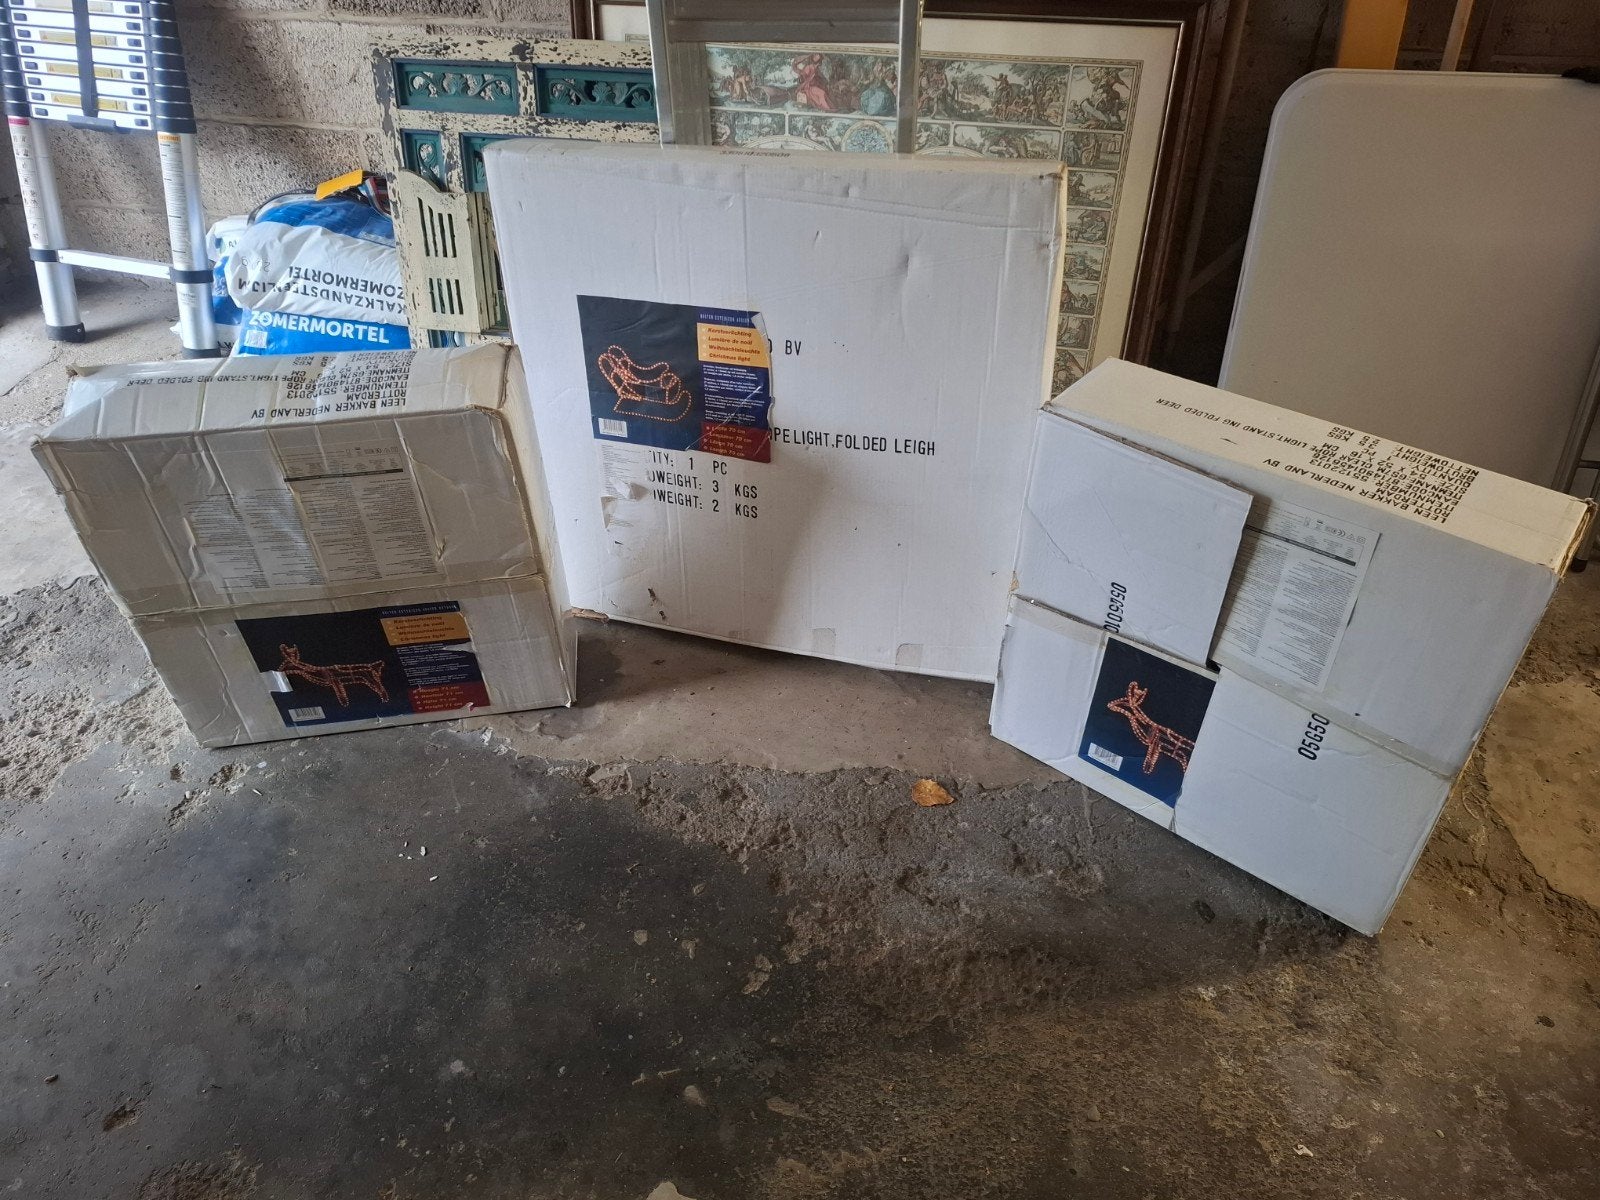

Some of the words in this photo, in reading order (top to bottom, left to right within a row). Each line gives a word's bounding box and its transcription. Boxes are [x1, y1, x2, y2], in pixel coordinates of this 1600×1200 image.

[250, 311, 390, 344] ZOMERMORTEL
[785, 340, 802, 356] BV
[158, 376, 193, 385] FOLDED
[347, 389, 406, 401] ROTTERDAM
[336, 401, 376, 411] BAKKER
[381, 398, 405, 407] LEEN
[1155, 398, 1182, 409] DEER
[251, 409, 265, 418] BV
[271, 404, 330, 417] NEDERLAND
[1184, 406, 1220, 422] FOLDED
[1222, 418, 1241, 428] ING
[1327, 431, 1350, 442] KGS
[1331, 426, 1354, 437] KGS
[895, 438, 935, 456] LEIGH
[1309, 445, 1337, 458] ROPE
[1322, 442, 1339, 452] CM
[1361, 448, 1376, 456] PC
[1349, 450, 1363, 459] 16
[650, 450, 674, 466] ITY:
[689, 457, 694, 470] 1
[713, 460, 728, 475] PC
[1263, 458, 1280, 467] BV
[1339, 454, 1373, 469] CLEAR
[1377, 459, 1394, 469] 52
[1309, 458, 1369, 482] 55122013
[1409, 470, 1427, 480] 54
[1284, 464, 1355, 492] NEDERLAND
[712, 480, 719, 493] 3
[734, 484, 758, 499] KGS
[653, 490, 702, 510] WEIGHT:
[712, 500, 720, 512] 2
[736, 503, 758, 518] KGS
[1358, 489, 1409, 510] BAKKER
[1375, 487, 1450, 517] ROTTERDAM
[1413, 507, 1447, 524] LEEN
[1297, 712, 1330, 761] 05G50
